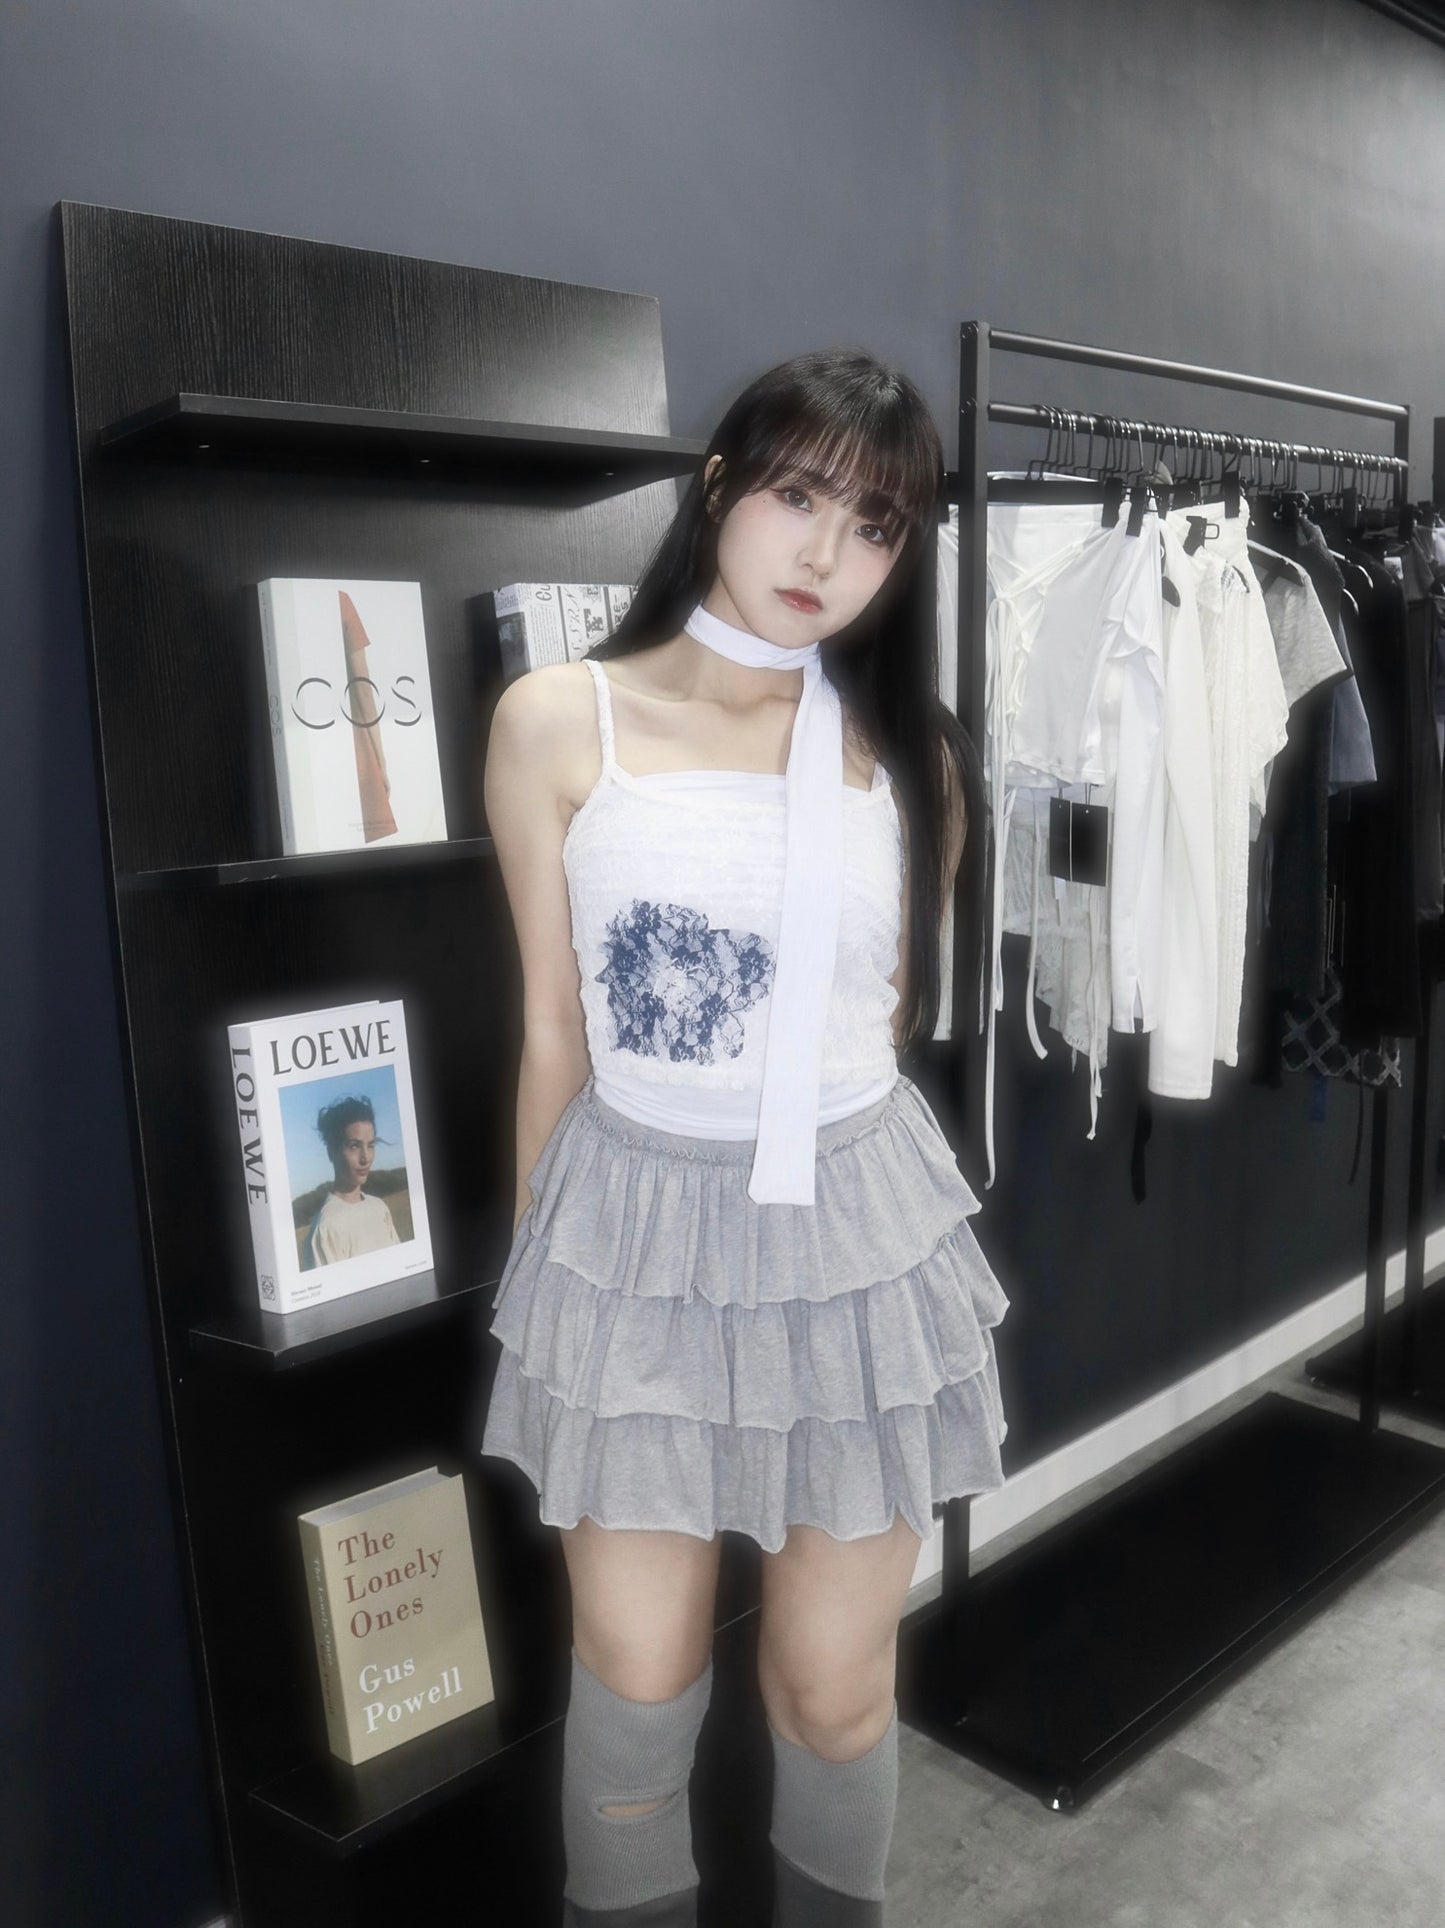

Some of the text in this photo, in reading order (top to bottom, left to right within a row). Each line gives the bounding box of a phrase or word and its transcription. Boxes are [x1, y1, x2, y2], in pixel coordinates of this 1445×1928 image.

[269, 694, 282, 737] COS
[291, 675, 422, 731] COS
[269, 1019, 397, 1077] LOEWE
[231, 1046, 269, 1206] LOEWE
[337, 1530, 396, 1567] The
[343, 1546, 444, 1605] Lonely
[350, 1596, 424, 1640] Ones
[358, 1655, 416, 1694] Gus
[363, 1665, 464, 1735] Powell
